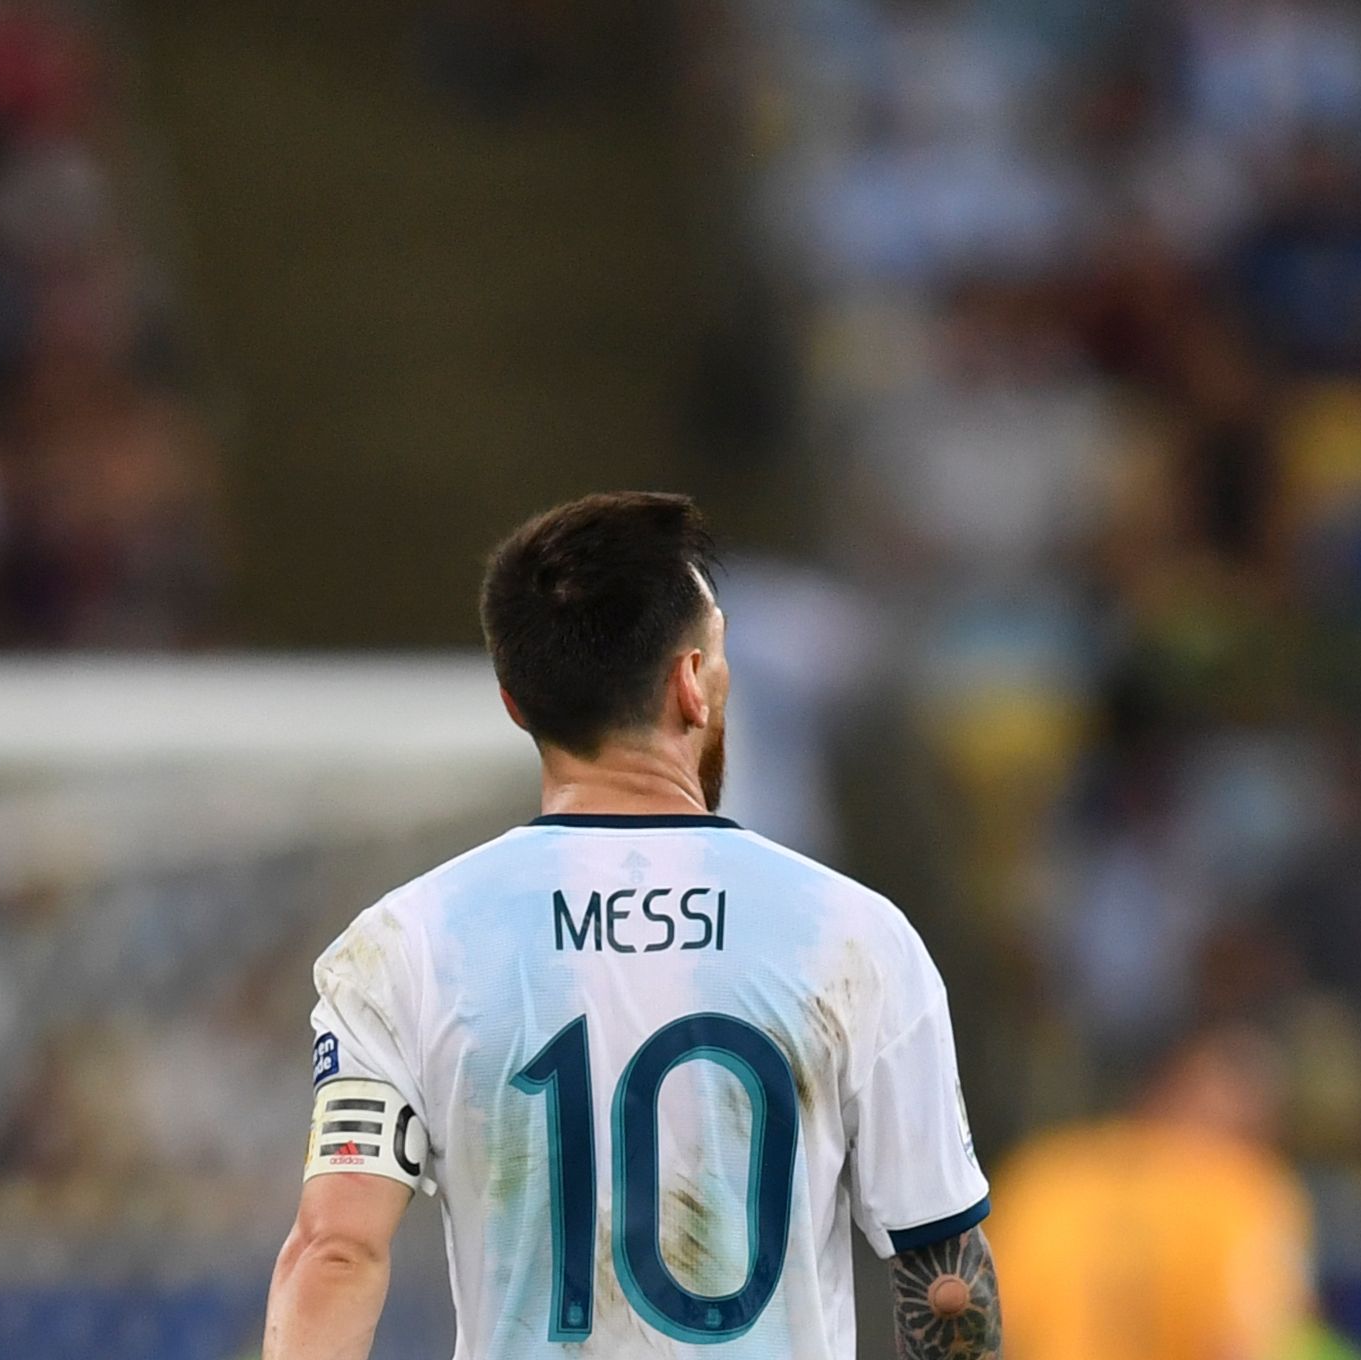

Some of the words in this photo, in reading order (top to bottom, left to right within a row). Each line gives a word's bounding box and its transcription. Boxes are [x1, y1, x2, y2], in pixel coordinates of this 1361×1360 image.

[552, 887, 726, 954] MESSI
[330, 1156, 365, 1165] adidas
[509, 1011, 800, 1344] 10
